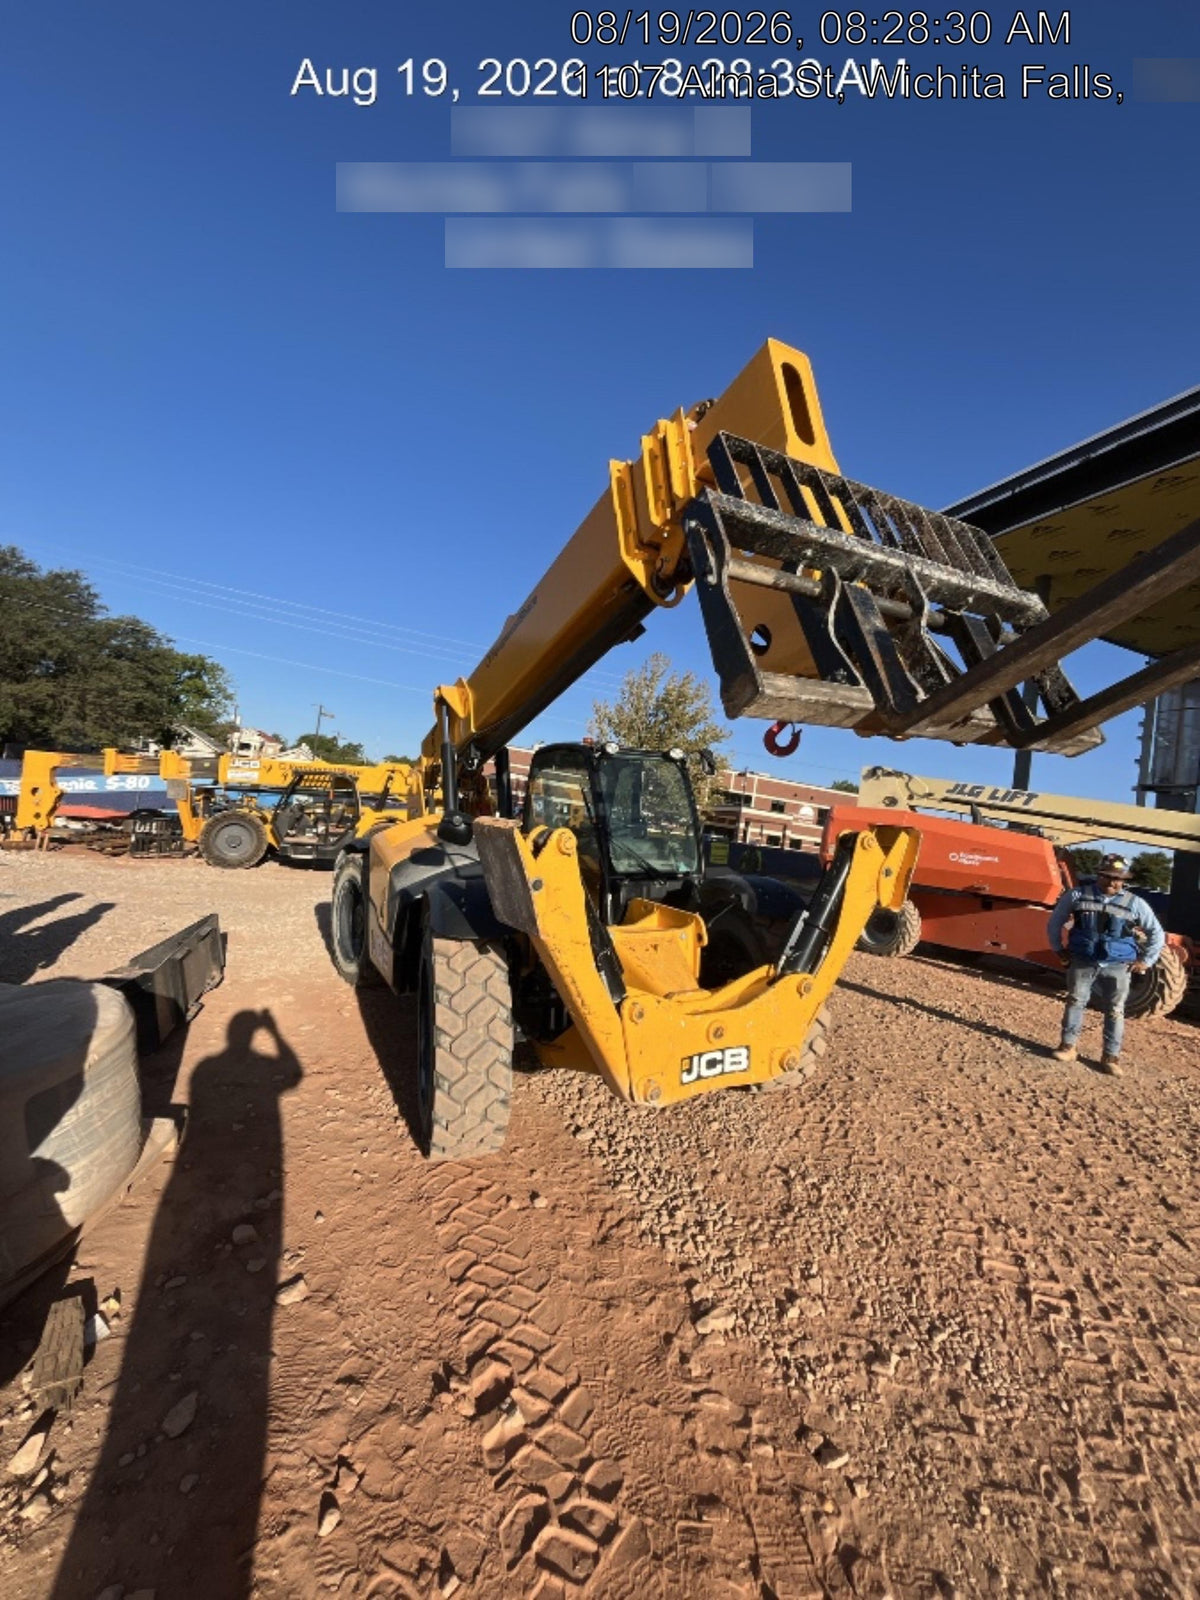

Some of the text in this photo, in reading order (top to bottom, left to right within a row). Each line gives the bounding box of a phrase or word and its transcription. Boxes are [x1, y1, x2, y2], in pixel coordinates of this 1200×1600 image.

[105, 776, 149, 791] S-80
[945, 783, 1039, 806] JLG LIFT
[681, 1047, 749, 1084] JCB
